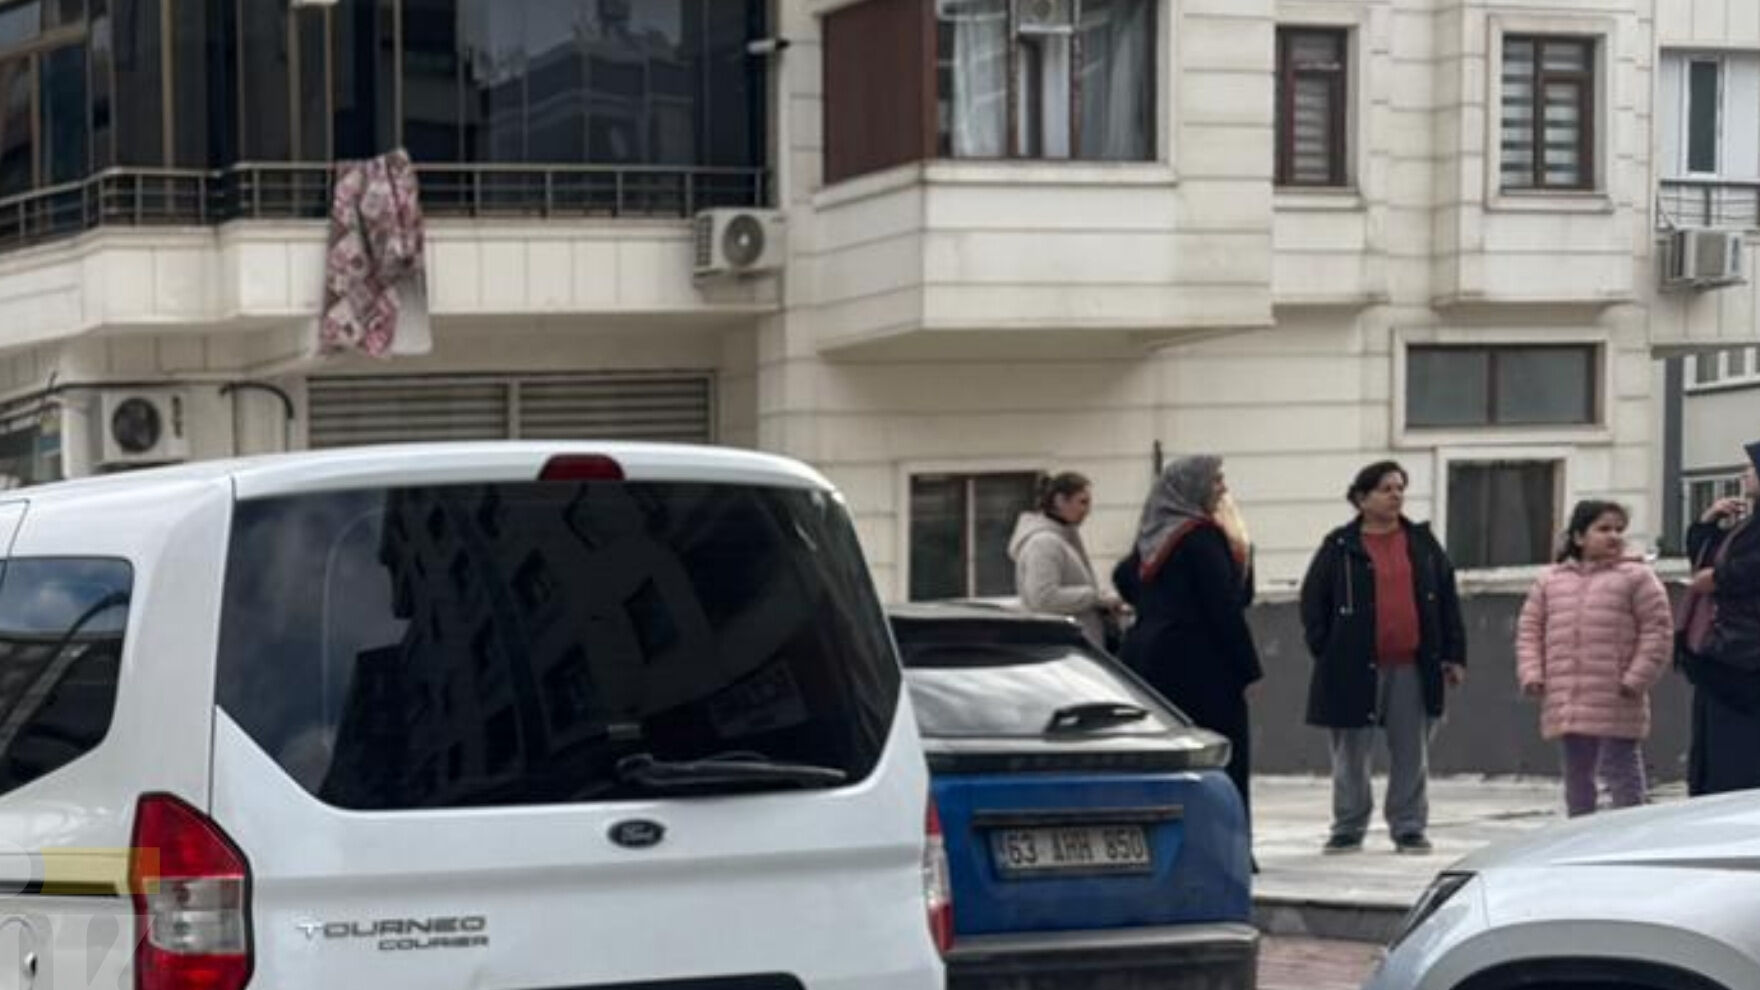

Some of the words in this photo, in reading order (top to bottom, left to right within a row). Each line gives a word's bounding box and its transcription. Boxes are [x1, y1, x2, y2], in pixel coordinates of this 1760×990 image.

[1006, 831, 1039, 864] 63
[296, 915, 486, 939] TOURNEO
[378, 936, 489, 951] COURIER
